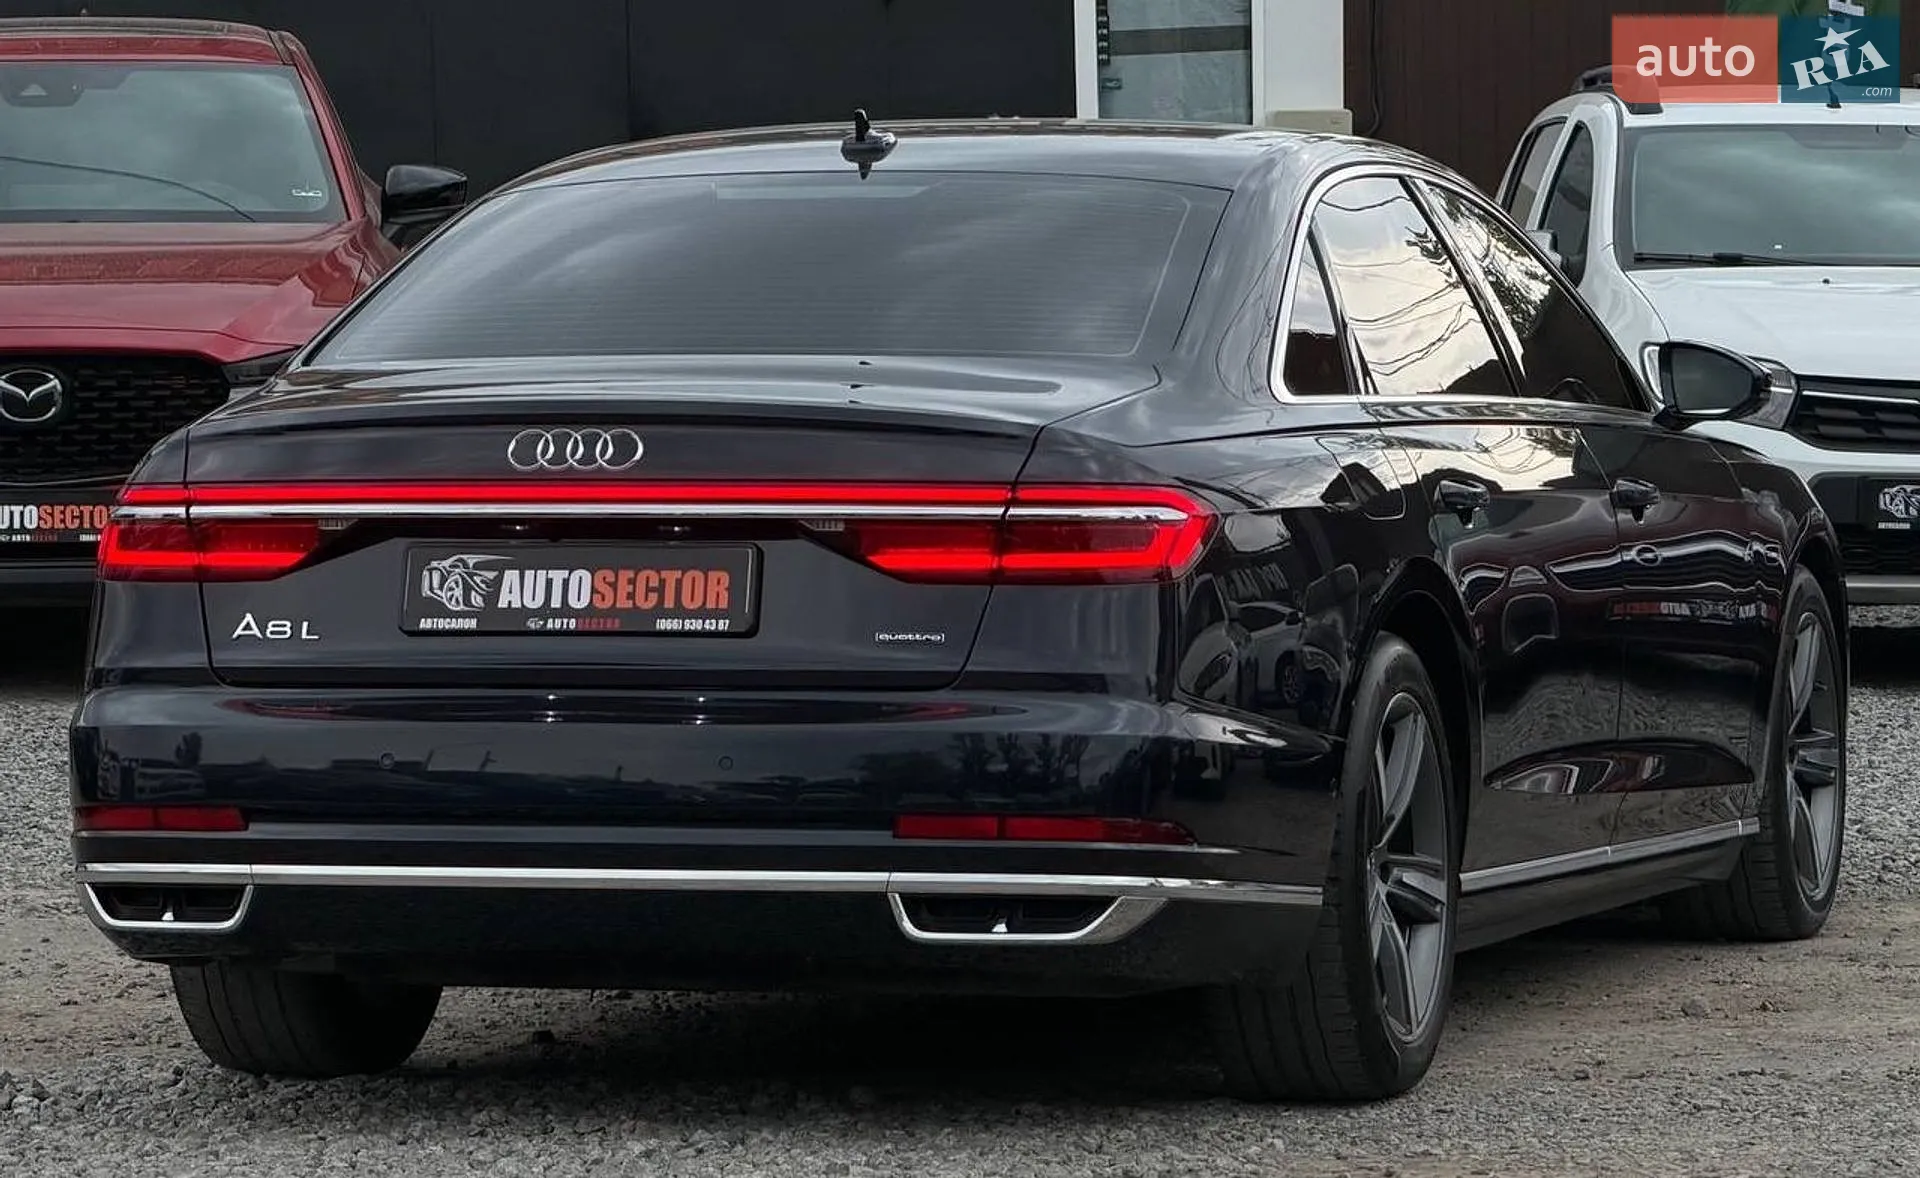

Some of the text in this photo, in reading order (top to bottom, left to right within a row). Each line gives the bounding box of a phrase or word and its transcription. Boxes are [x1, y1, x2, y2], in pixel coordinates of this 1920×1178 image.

[497, 568, 730, 610] AUTOSECTOR
[231, 612, 320, 639] A8 L
[418, 617, 478, 630] АВТОСАЛОН
[655, 618, 683, 630] (066)
[703, 618, 717, 630] 43
